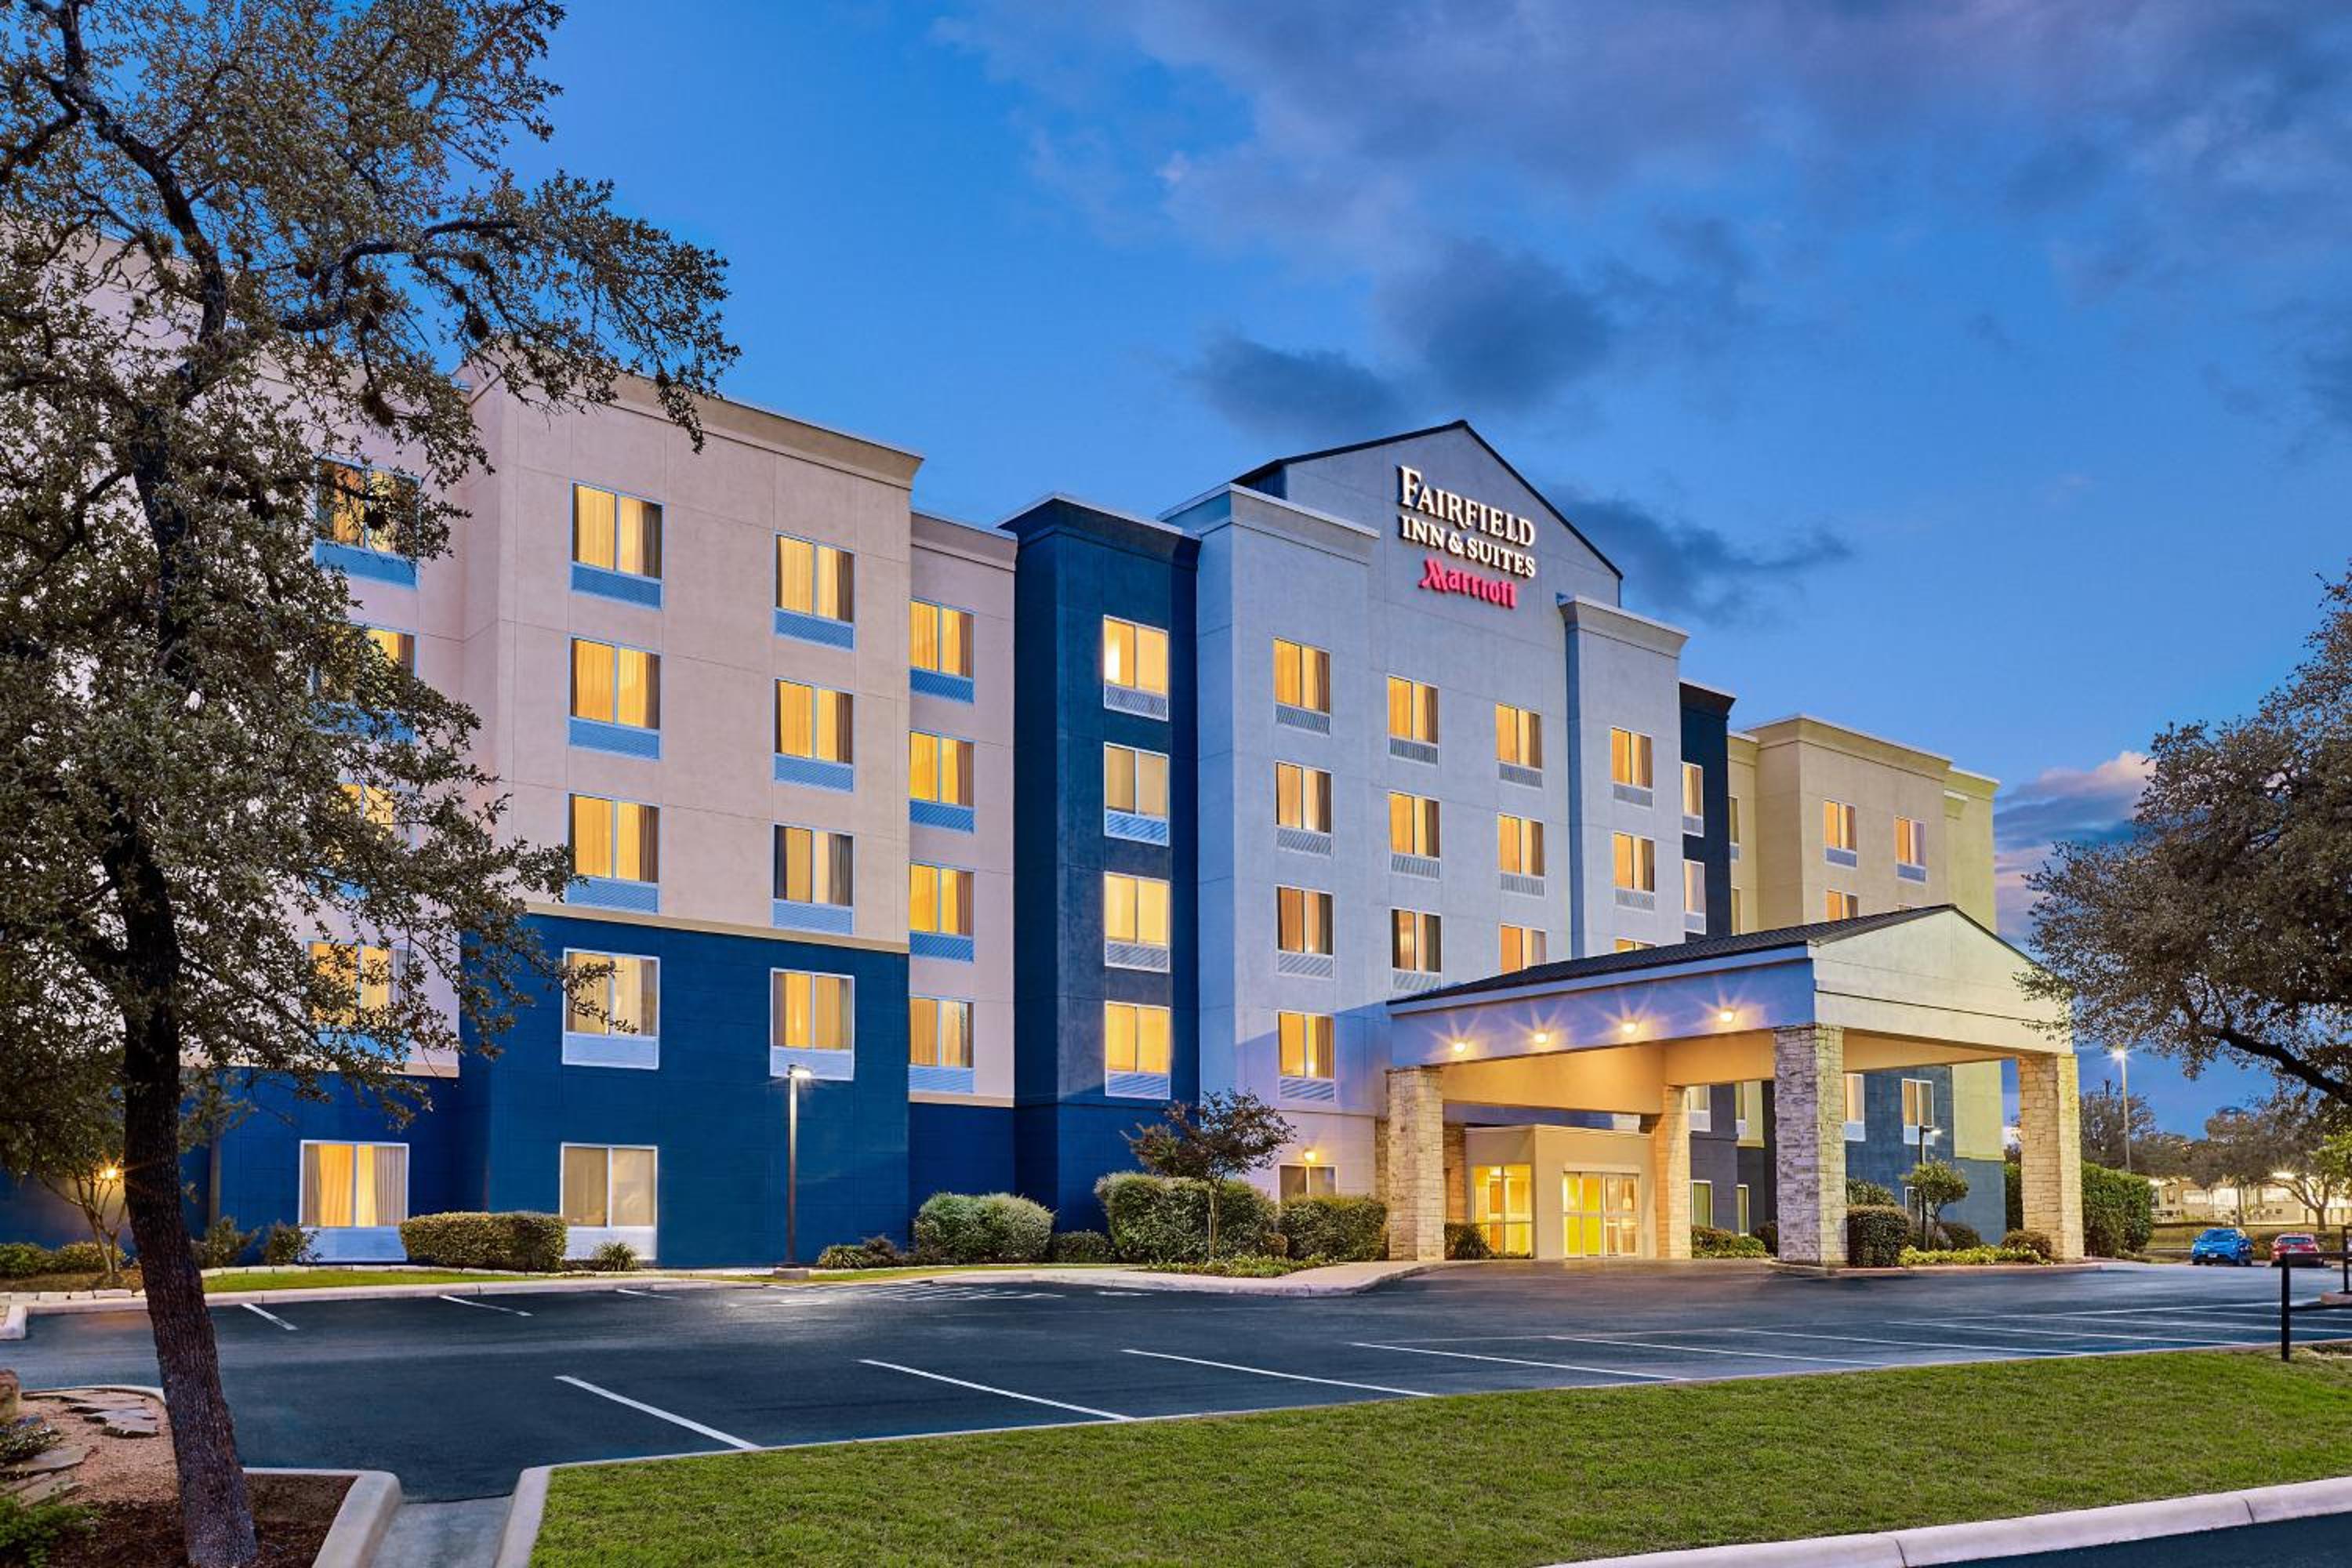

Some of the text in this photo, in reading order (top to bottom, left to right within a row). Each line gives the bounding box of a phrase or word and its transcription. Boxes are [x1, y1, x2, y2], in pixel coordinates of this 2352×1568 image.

[1398, 466, 1535, 547] FAIRFIELD
[1399, 514, 1537, 578] INN & SUITES
[1419, 558, 1516, 608] Marriott
